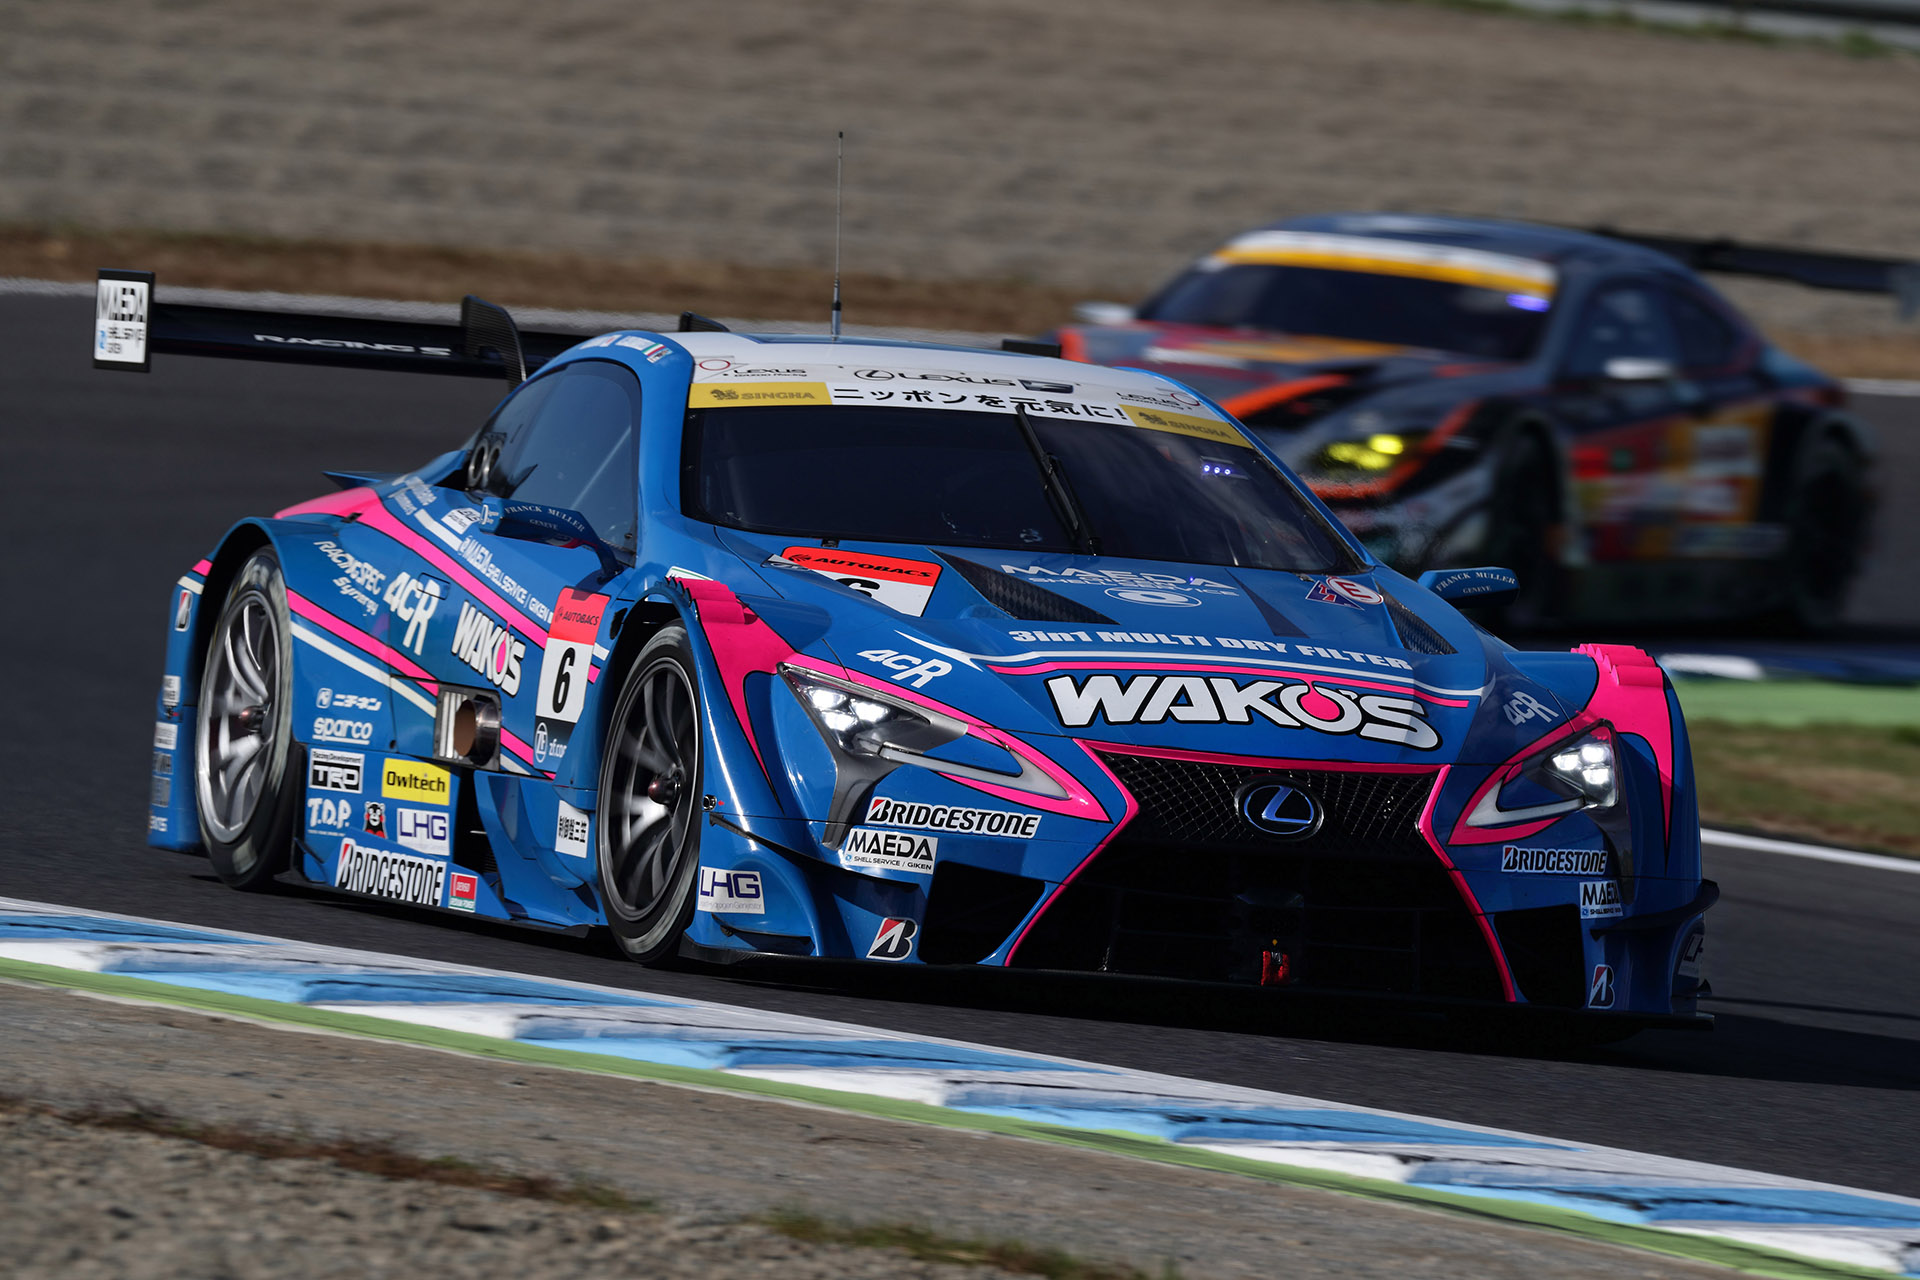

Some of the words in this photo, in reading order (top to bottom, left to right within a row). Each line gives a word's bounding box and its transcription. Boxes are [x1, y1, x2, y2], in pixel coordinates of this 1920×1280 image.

[254, 334, 415, 352] RACING
[897, 372, 1017, 386] LEXUS
[741, 392, 816, 400] SINGHA
[504, 505, 542, 514] FRANCK
[547, 508, 585, 532] MULLER
[814, 557, 933, 578] AUTOBACS
[1001, 564, 1237, 590] MAEDA
[1436, 571, 1471, 592] FRANCK
[1475, 571, 1516, 584] MULLER
[1462, 586, 1492, 594] GENEVE
[383, 571, 441, 656] 4CR
[562, 610, 600, 626] AUTOBACS
[451, 599, 527, 698] WAKO'S
[1095, 631, 1212, 647] MULTI
[1215, 636, 1288, 653] DRY
[1295, 644, 1414, 671] FILTER
[552, 647, 576, 714] 6
[856, 649, 952, 688] 4CR
[1046, 674, 1442, 750] WAKO'S
[1502, 691, 1559, 726] 4CR
[313, 717, 373, 742] sparco
[313, 764, 359, 790] TRD
[386, 770, 446, 793] Owltech
[399, 811, 447, 841] LHG
[866, 797, 1041, 838] BRIDGESTONE
[848, 831, 934, 861] MAEDA
[337, 840, 445, 907] BRIDGESTONE
[907, 862, 932, 870] GIKEN
[1502, 846, 1607, 874] BRIDGESTONE
[700, 869, 760, 899] LHG
